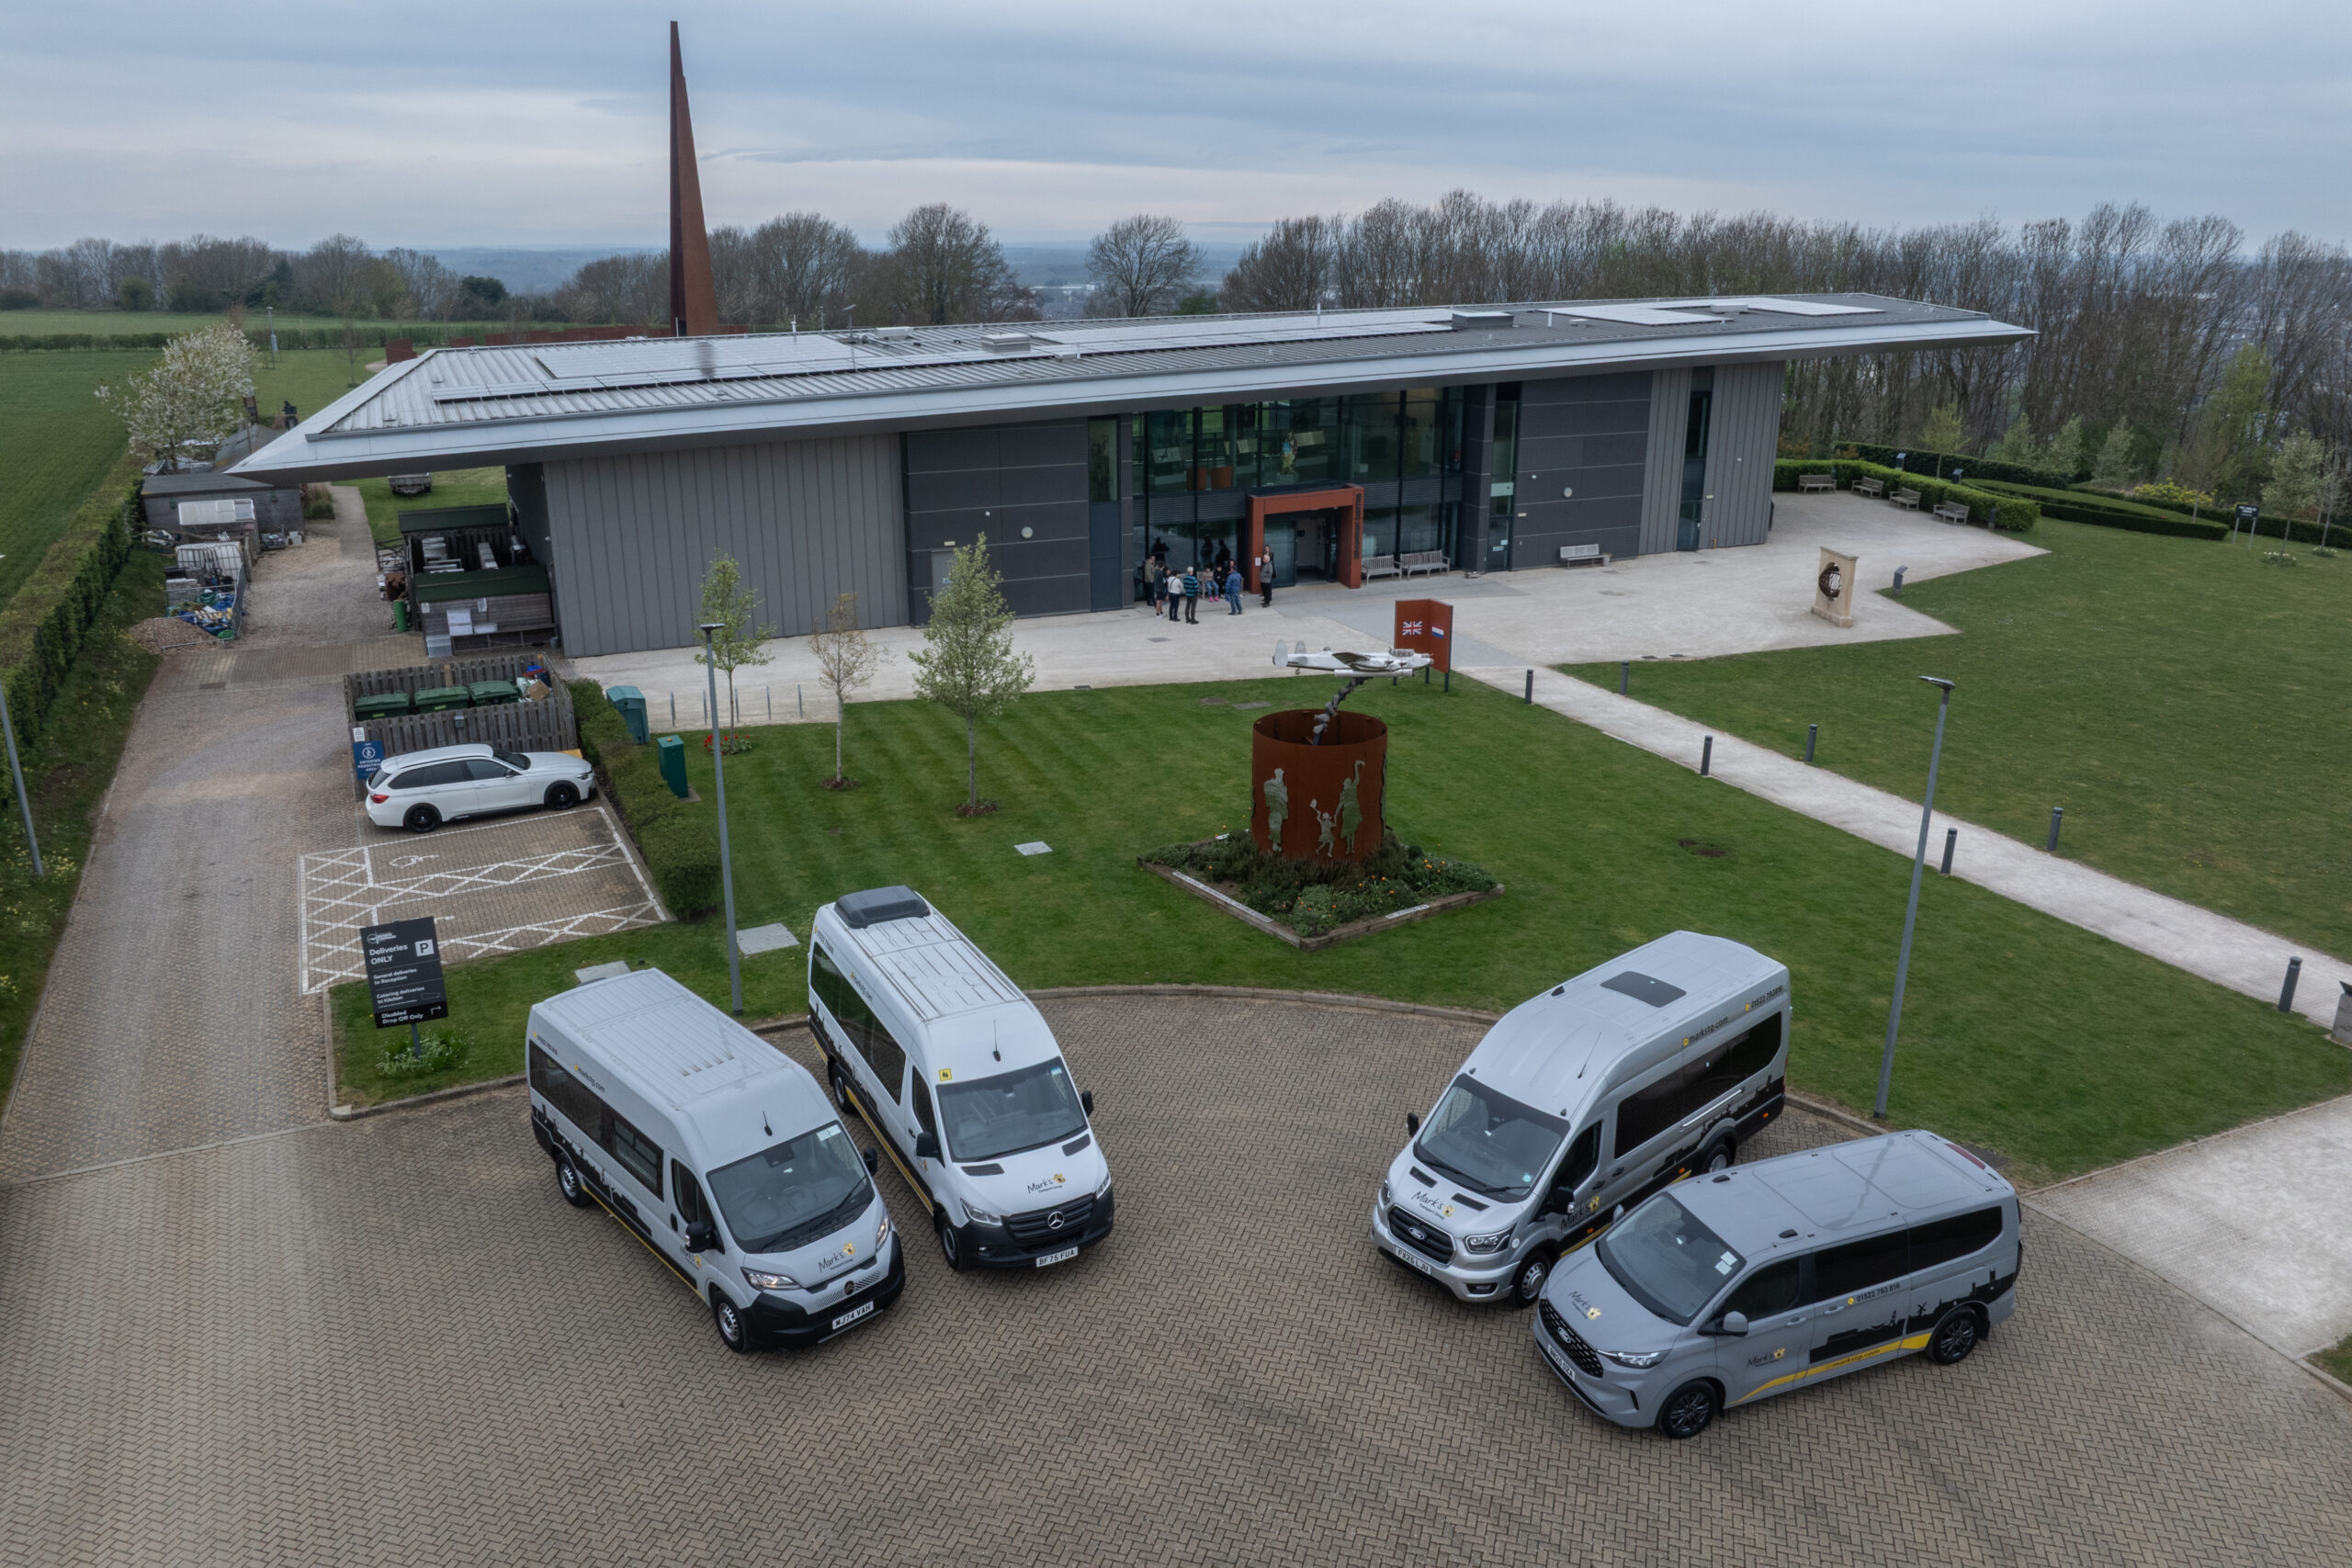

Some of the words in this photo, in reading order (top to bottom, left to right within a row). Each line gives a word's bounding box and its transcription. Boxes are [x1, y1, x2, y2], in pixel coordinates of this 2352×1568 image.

[369, 943, 409, 956] Deliveries
[420, 942, 429, 953] P
[370, 955, 393, 965] ONLY
[373, 972, 393, 980] General
[381, 976, 408, 985] Reception
[377, 990, 400, 999] Catering
[400, 987, 424, 995] deliveries
[381, 1010, 407, 1019] Disabled
[1027, 1179, 1054, 1194] Mark's
[1411, 1191, 1444, 1210] Mark's
[818, 1250, 845, 1273] Mark's
[1039, 1255, 1059, 1266] BF75
[1060, 1249, 1075, 1260] FUA
[1397, 1249, 1415, 1264] FX25
[1415, 1259, 1429, 1272] LJU
[1857, 1291, 1875, 1302] 01522
[835, 1312, 855, 1326] MJ74
[856, 1304, 871, 1317] VAH
